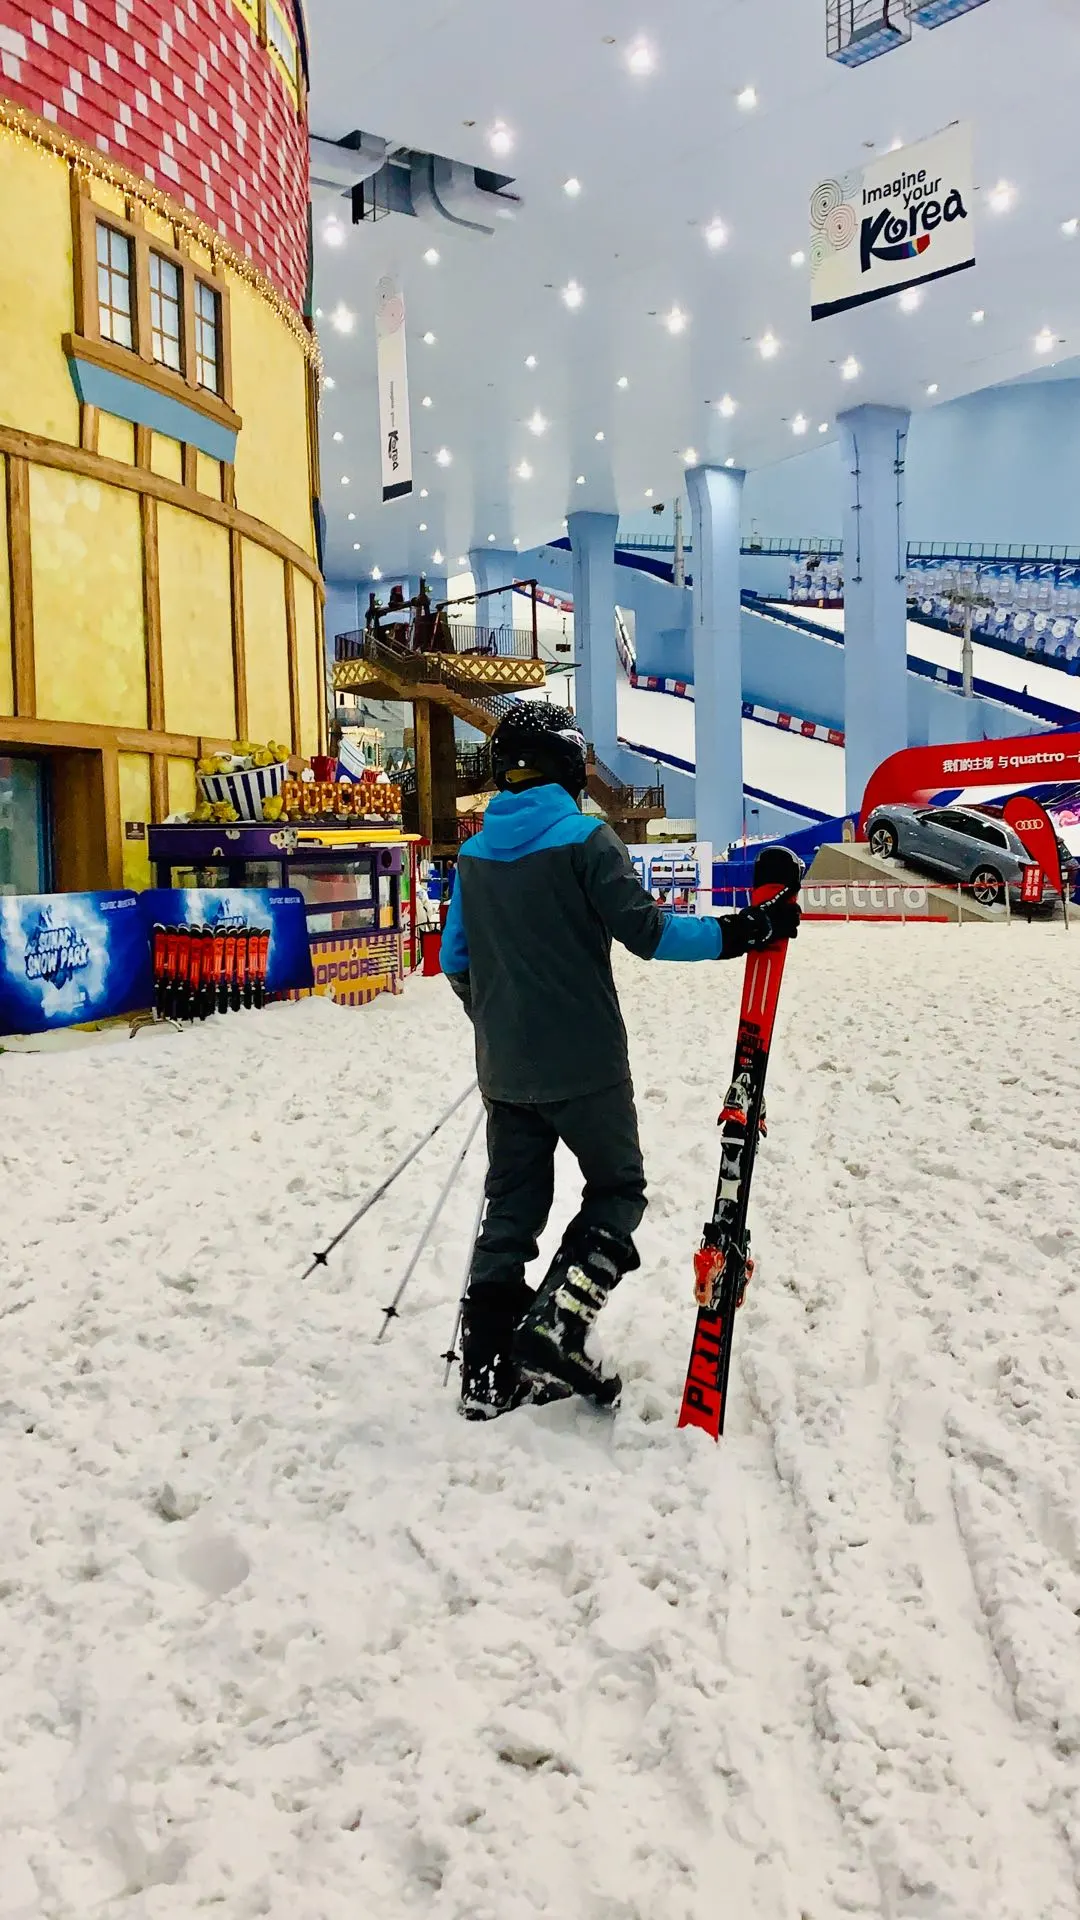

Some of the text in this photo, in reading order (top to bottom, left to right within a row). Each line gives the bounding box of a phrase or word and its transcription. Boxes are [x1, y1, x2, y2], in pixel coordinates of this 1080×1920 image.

[862, 169, 926, 205] Imagine
[903, 178, 942, 209] your
[860, 189, 967, 273] Korea
[388, 430, 399, 471] Korea
[942, 757, 994, 773] 我们的主场
[27, 943, 89, 978] SNOW PARK
